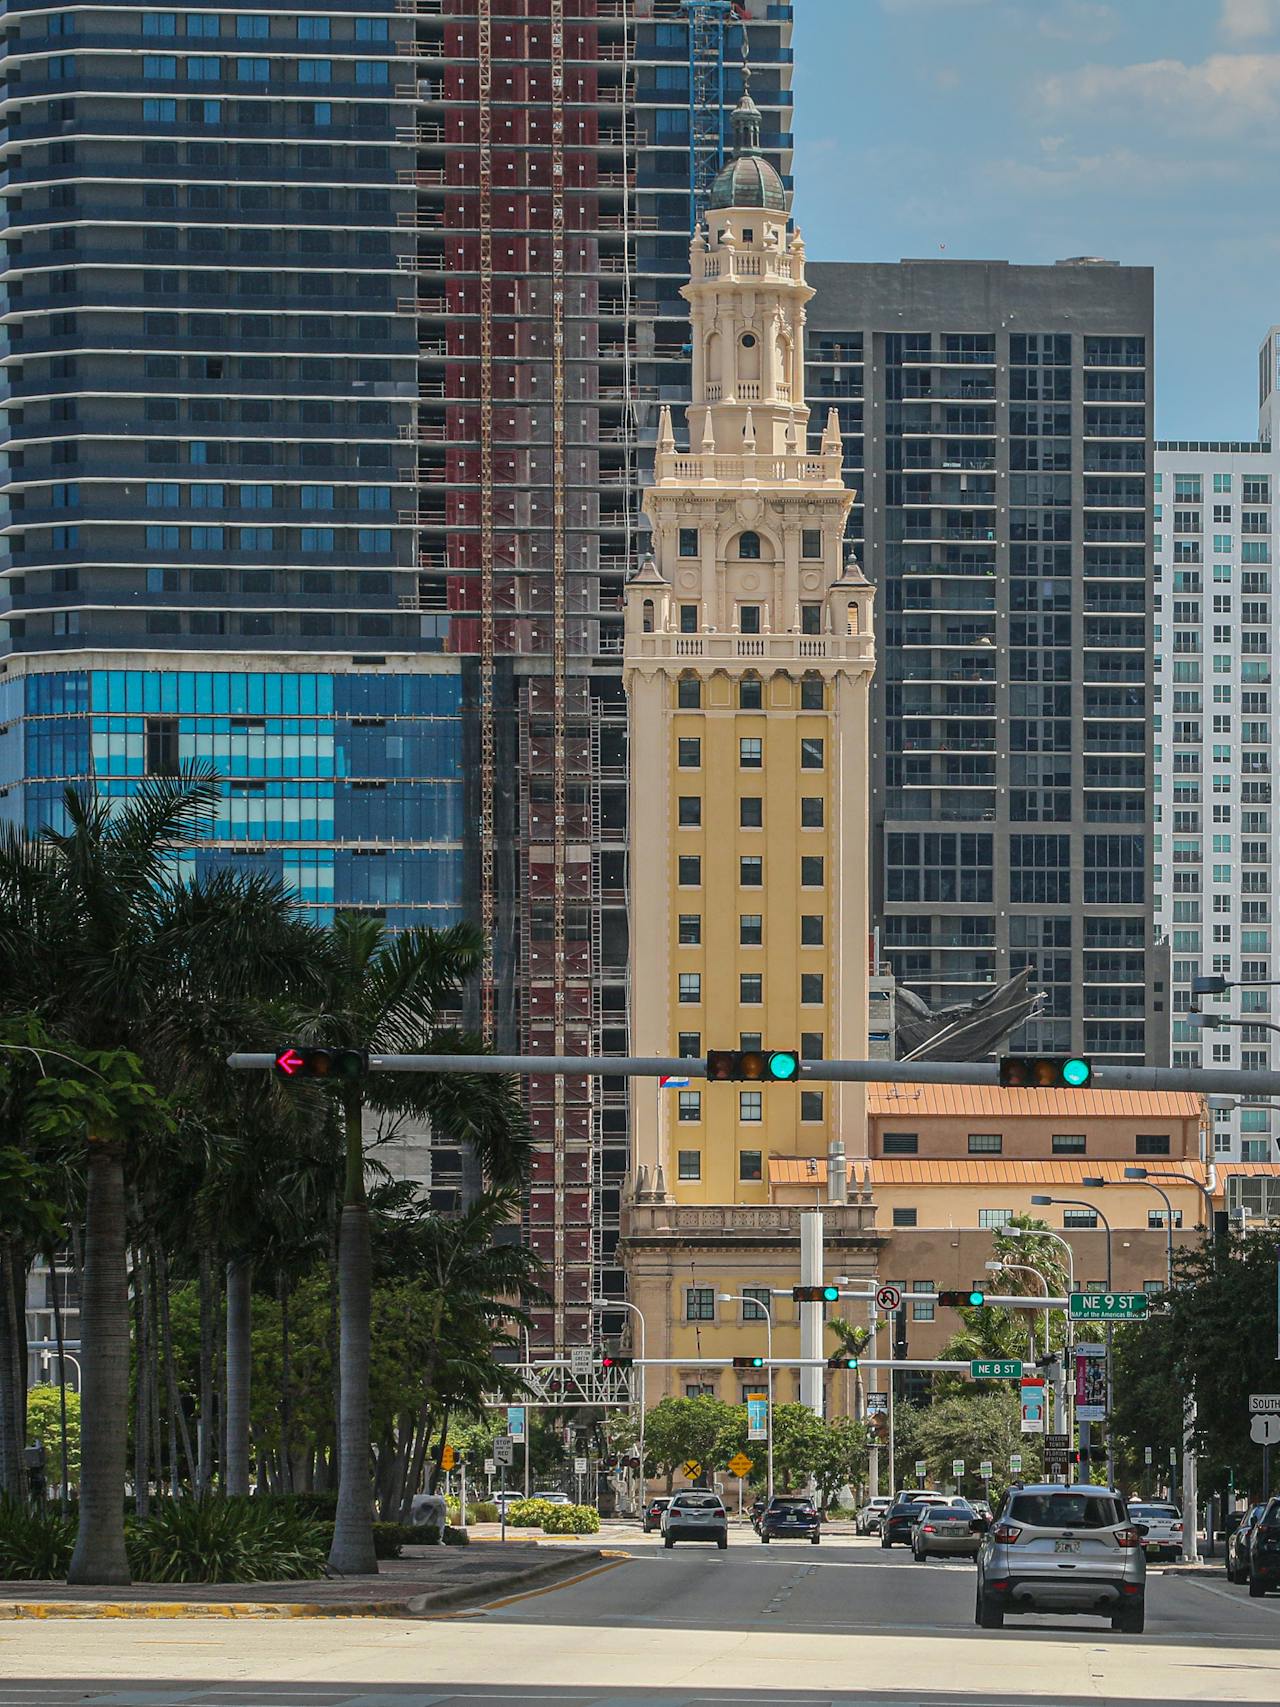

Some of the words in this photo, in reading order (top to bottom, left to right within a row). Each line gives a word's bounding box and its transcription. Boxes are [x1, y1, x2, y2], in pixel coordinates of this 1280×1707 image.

[1082, 1296, 1100, 1309] NE
[1104, 1295, 1114, 1310] 9
[1119, 1296, 1135, 1309] ST
[978, 1365, 990, 1374] NE
[994, 1364, 1000, 1374] 8
[1004, 1365, 1015, 1373] ST
[1252, 1398, 1280, 1409] SOUTH
[1264, 1420, 1269, 1438] 1
